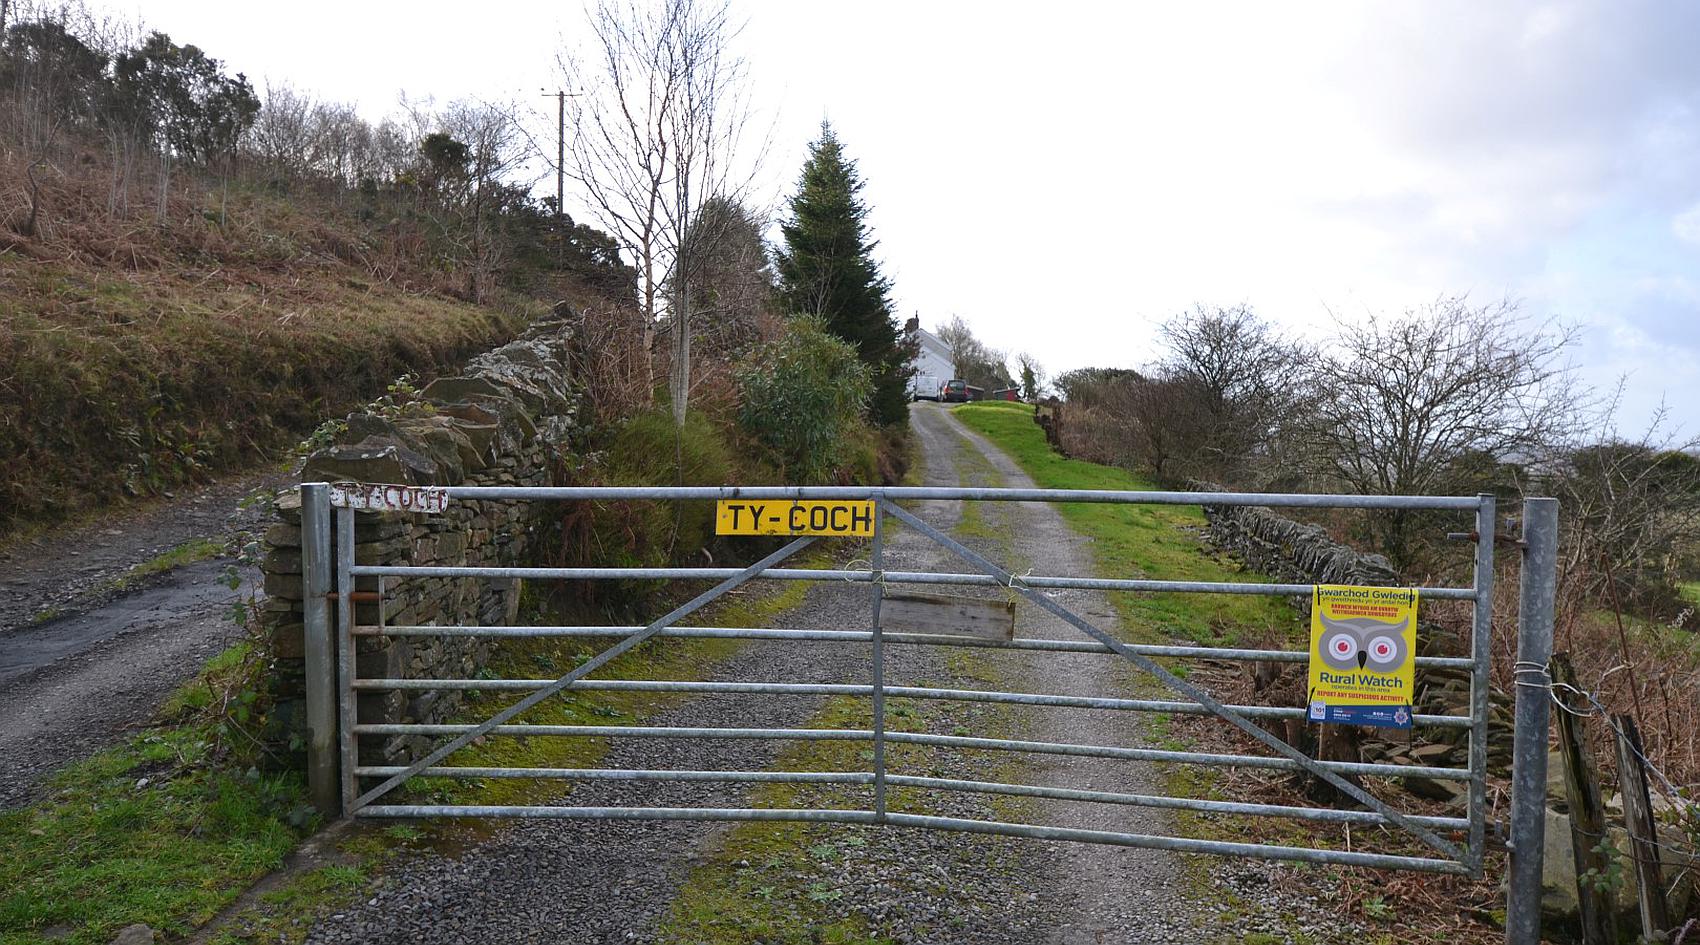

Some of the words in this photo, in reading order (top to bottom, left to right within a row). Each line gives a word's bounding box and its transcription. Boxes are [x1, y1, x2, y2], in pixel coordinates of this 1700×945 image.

[1319, 588, 1368, 598] Gwarchod
[1372, 591, 1415, 602] Gwledig
[1320, 672, 1355, 684] Rural
[1358, 674, 1403, 688] Watch
